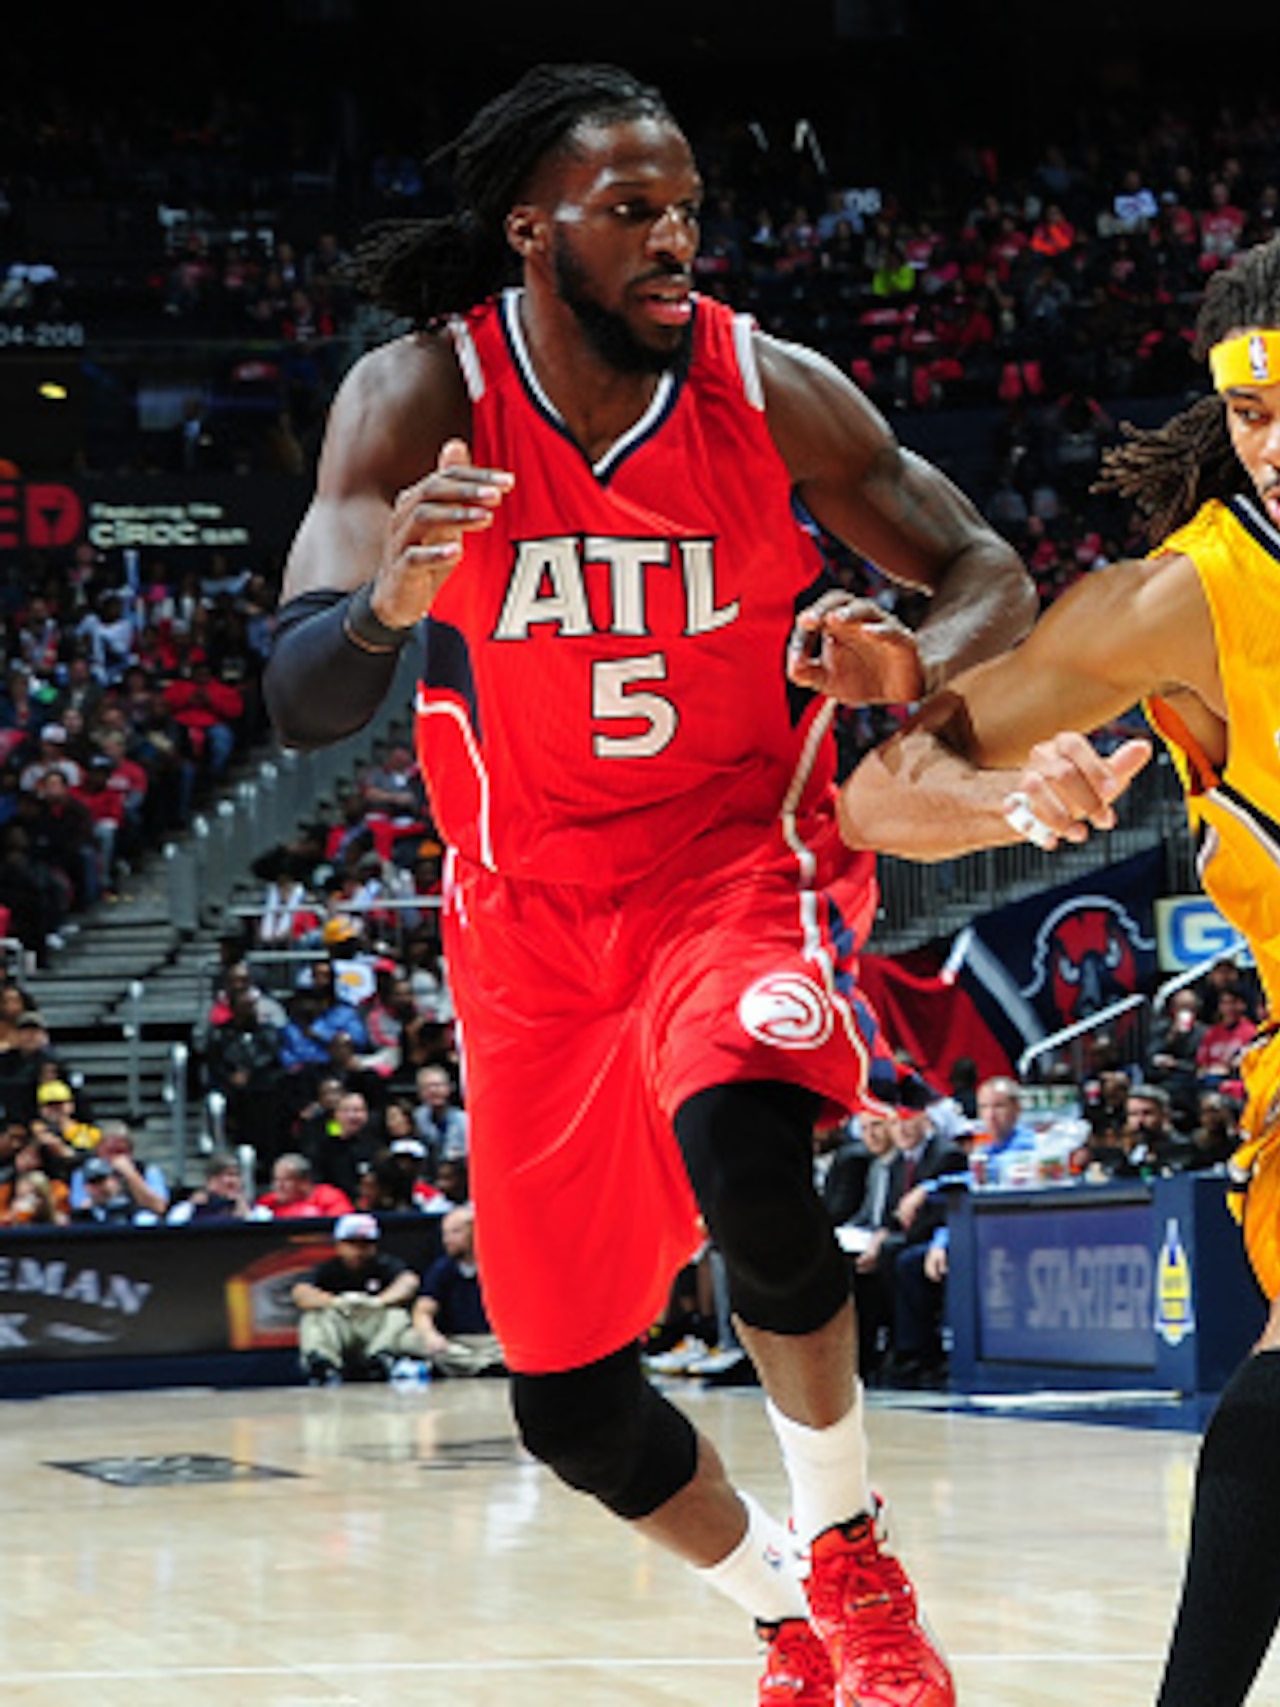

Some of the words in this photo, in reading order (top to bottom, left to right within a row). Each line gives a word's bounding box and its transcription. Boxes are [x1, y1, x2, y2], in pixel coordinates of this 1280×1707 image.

[490, 533, 741, 640] ATL
[590, 650, 679, 759] 5
[1026, 1244, 1153, 1331] STARTER
